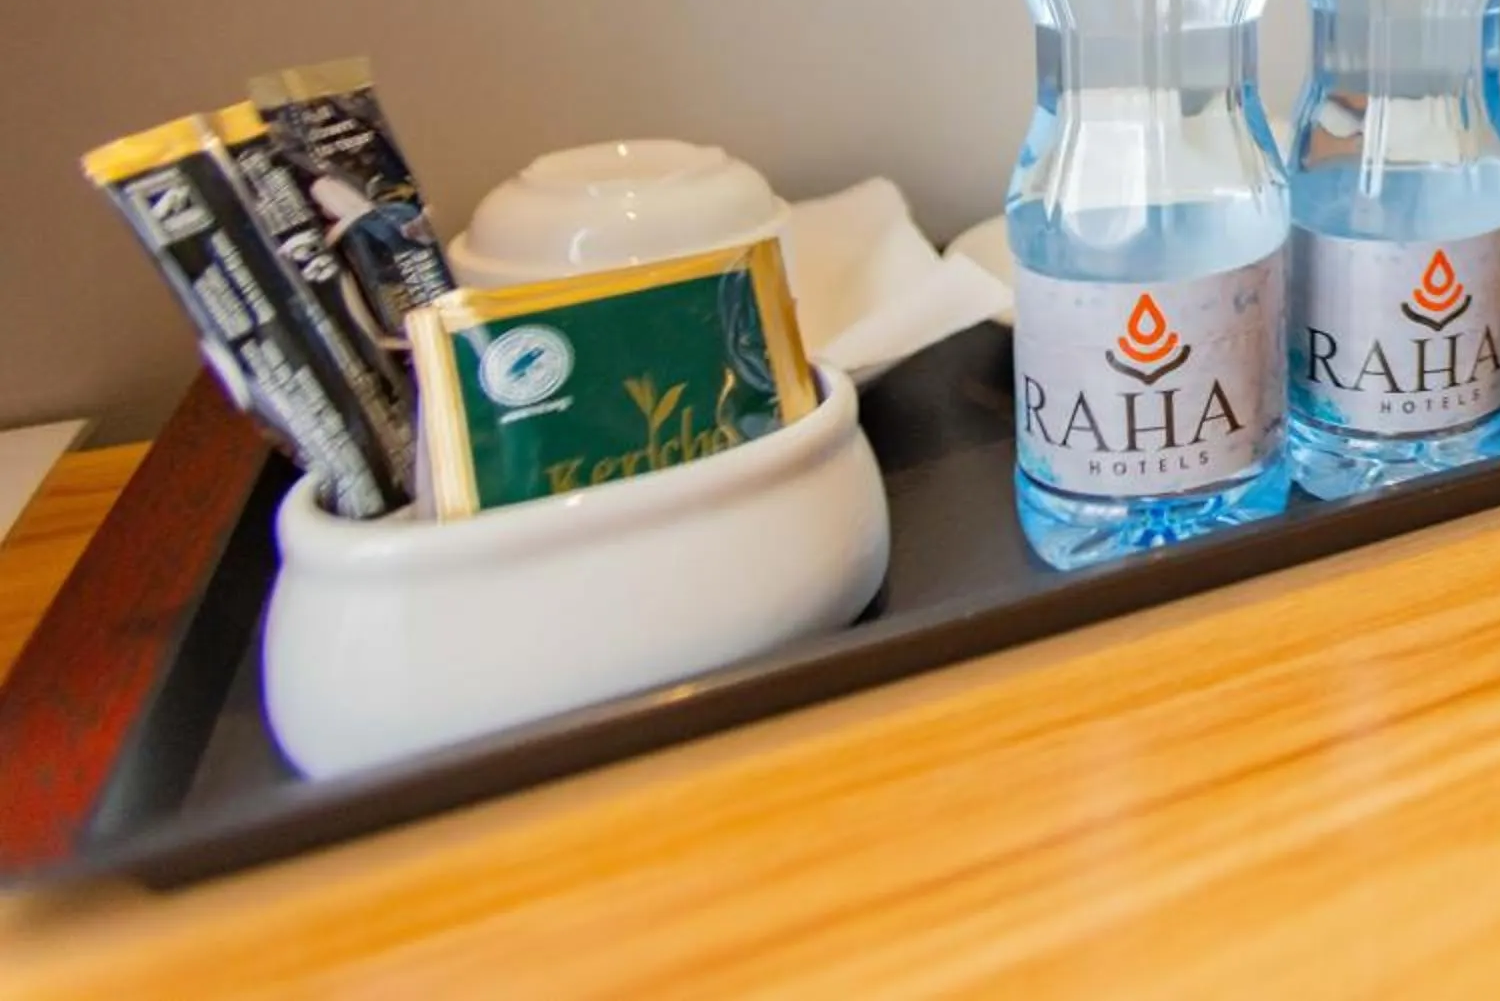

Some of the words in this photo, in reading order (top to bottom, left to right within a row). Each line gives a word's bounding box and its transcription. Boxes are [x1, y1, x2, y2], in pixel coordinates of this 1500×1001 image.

[1022, 374, 1246, 453] RAHA
[1380, 388, 1482, 414] HOTELS
[1089, 451, 1210, 477] HOTELS
